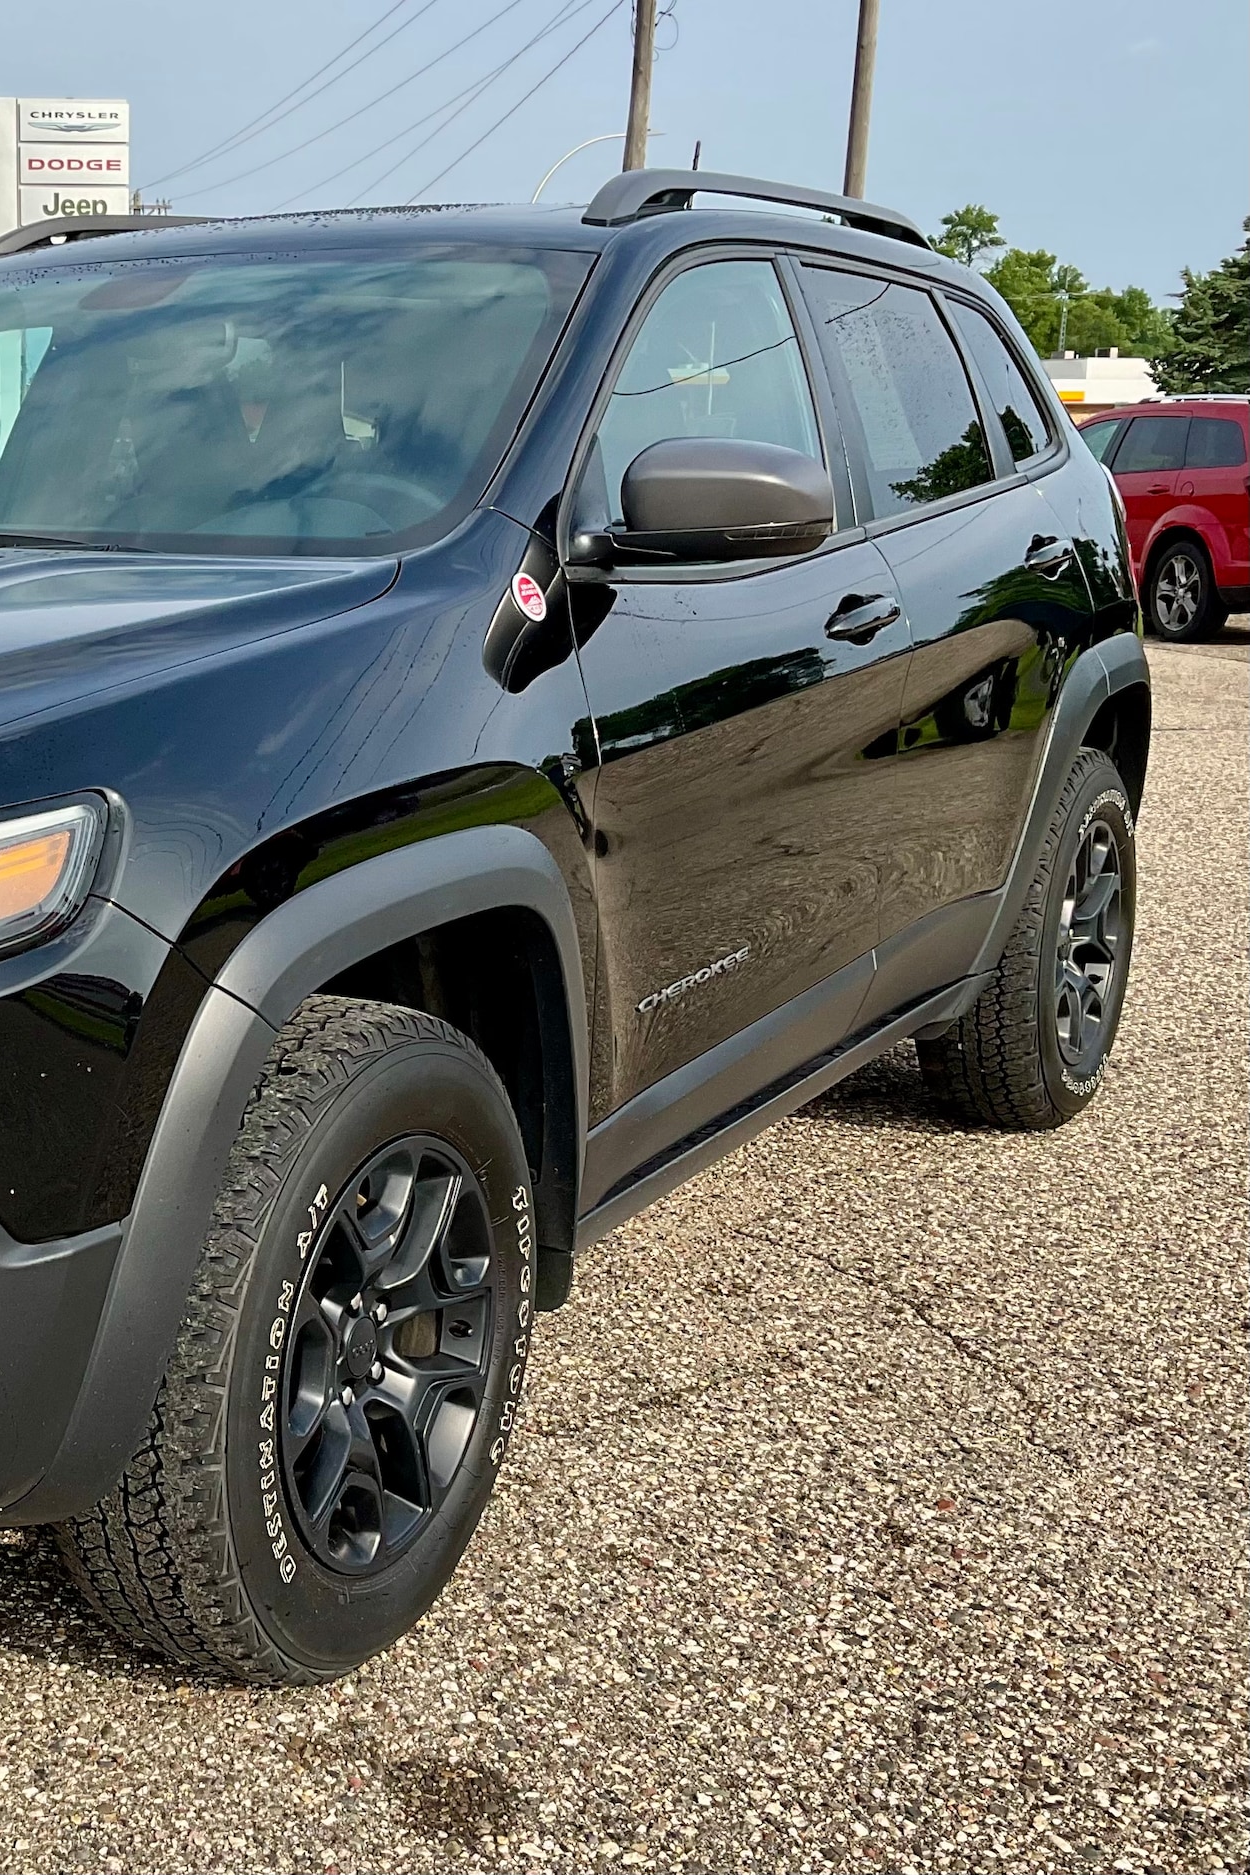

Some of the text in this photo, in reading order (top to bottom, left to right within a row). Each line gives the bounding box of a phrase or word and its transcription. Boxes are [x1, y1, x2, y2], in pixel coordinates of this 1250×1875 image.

[30, 111, 119, 119] CHRYSLER
[28, 158, 122, 171] DODGE
[638, 946, 749, 1013] CHEROKEE
[259, 1183, 330, 1585] DESTINATION A/T
